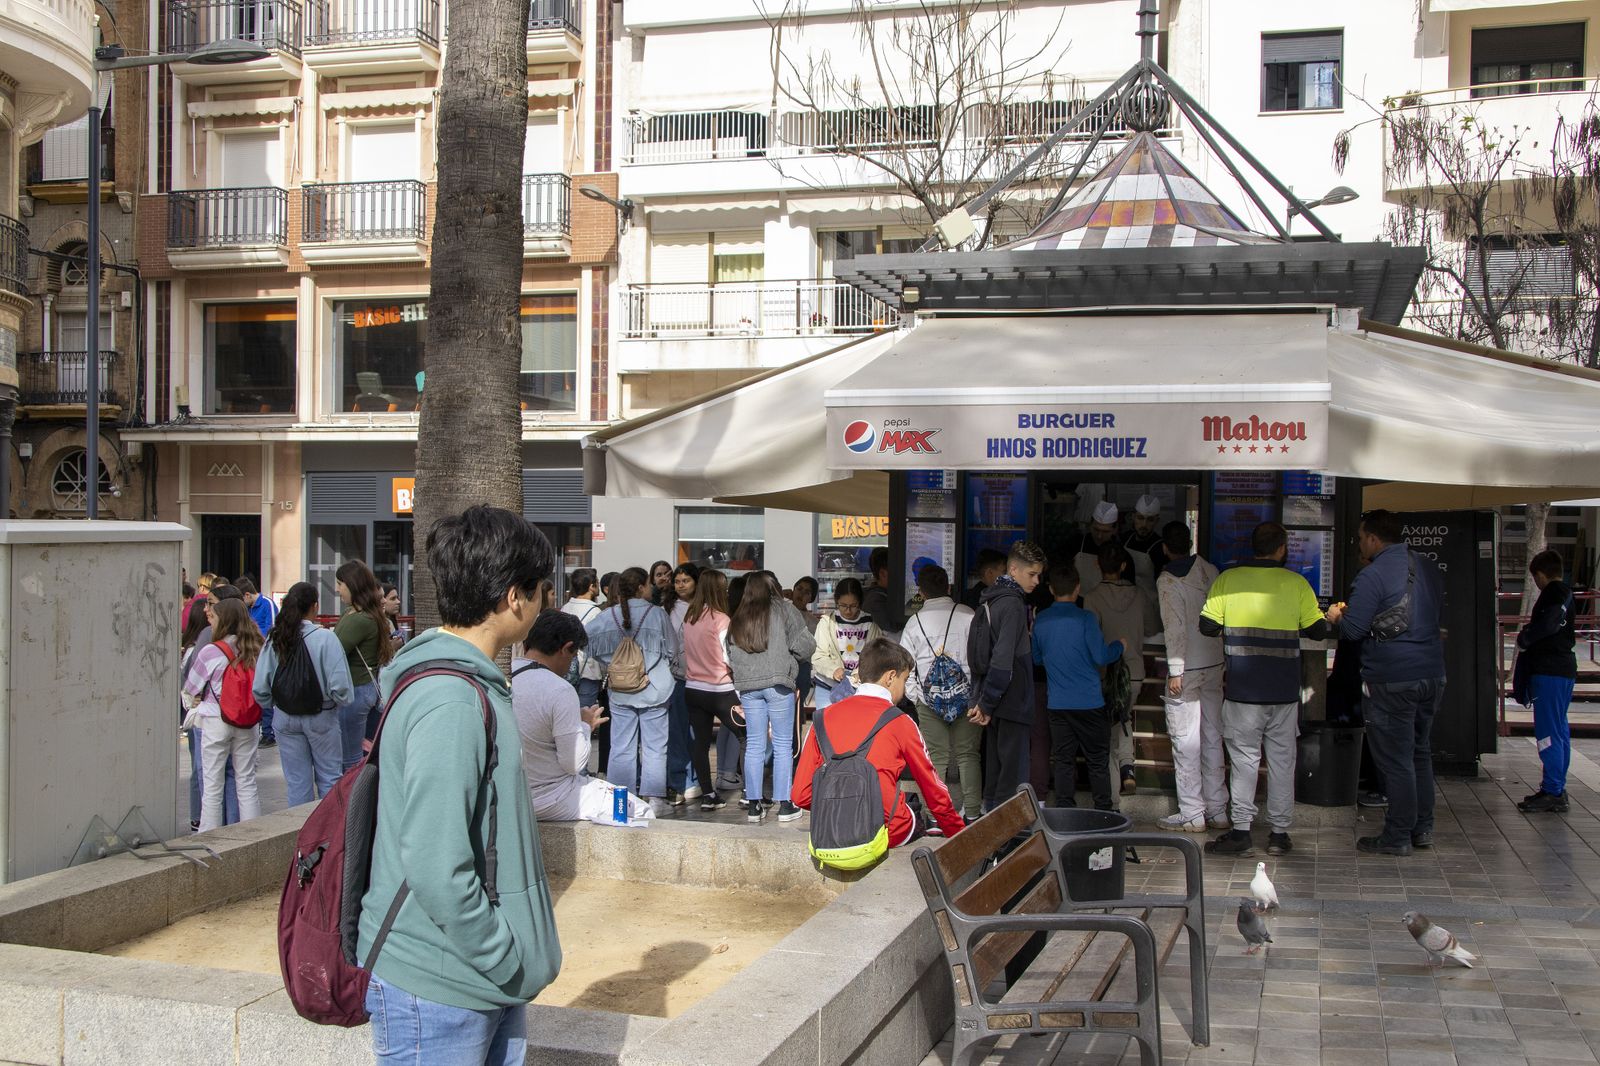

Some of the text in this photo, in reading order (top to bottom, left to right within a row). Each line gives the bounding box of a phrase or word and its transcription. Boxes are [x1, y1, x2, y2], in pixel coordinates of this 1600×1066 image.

[883, 417, 911, 428] pepsi
[1018, 413, 1115, 429] BURGUER
[1200, 414, 1307, 442] Mahou
[879, 429, 941, 452] MAX
[987, 437, 1147, 459] HNOS RODRIGUEZ
[278, 500, 293, 510] 15
[1401, 525, 1449, 535] ÁXIMO
[1403, 537, 1443, 546] ABOR
